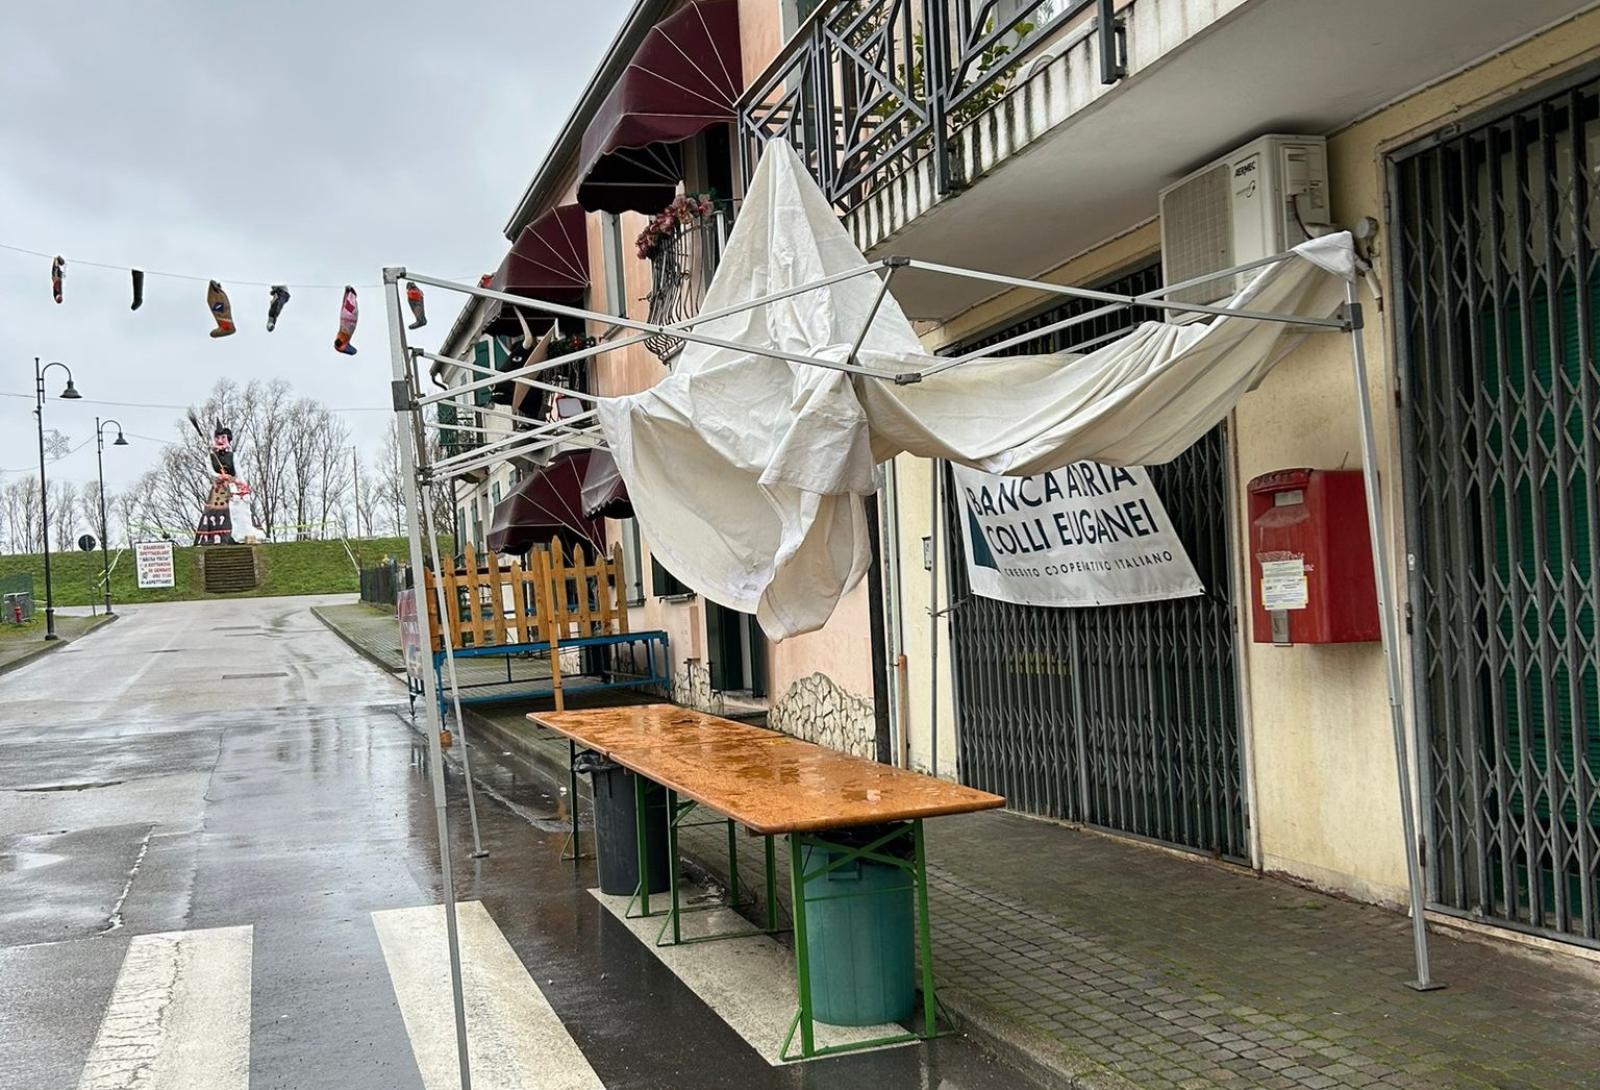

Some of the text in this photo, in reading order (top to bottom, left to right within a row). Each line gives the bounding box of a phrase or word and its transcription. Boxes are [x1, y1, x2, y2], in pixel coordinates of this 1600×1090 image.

[966, 471, 1064, 516] BANCA
[986, 498, 1160, 555] COLLI EUGANEI
[1115, 551, 1173, 570] ITALIANO
